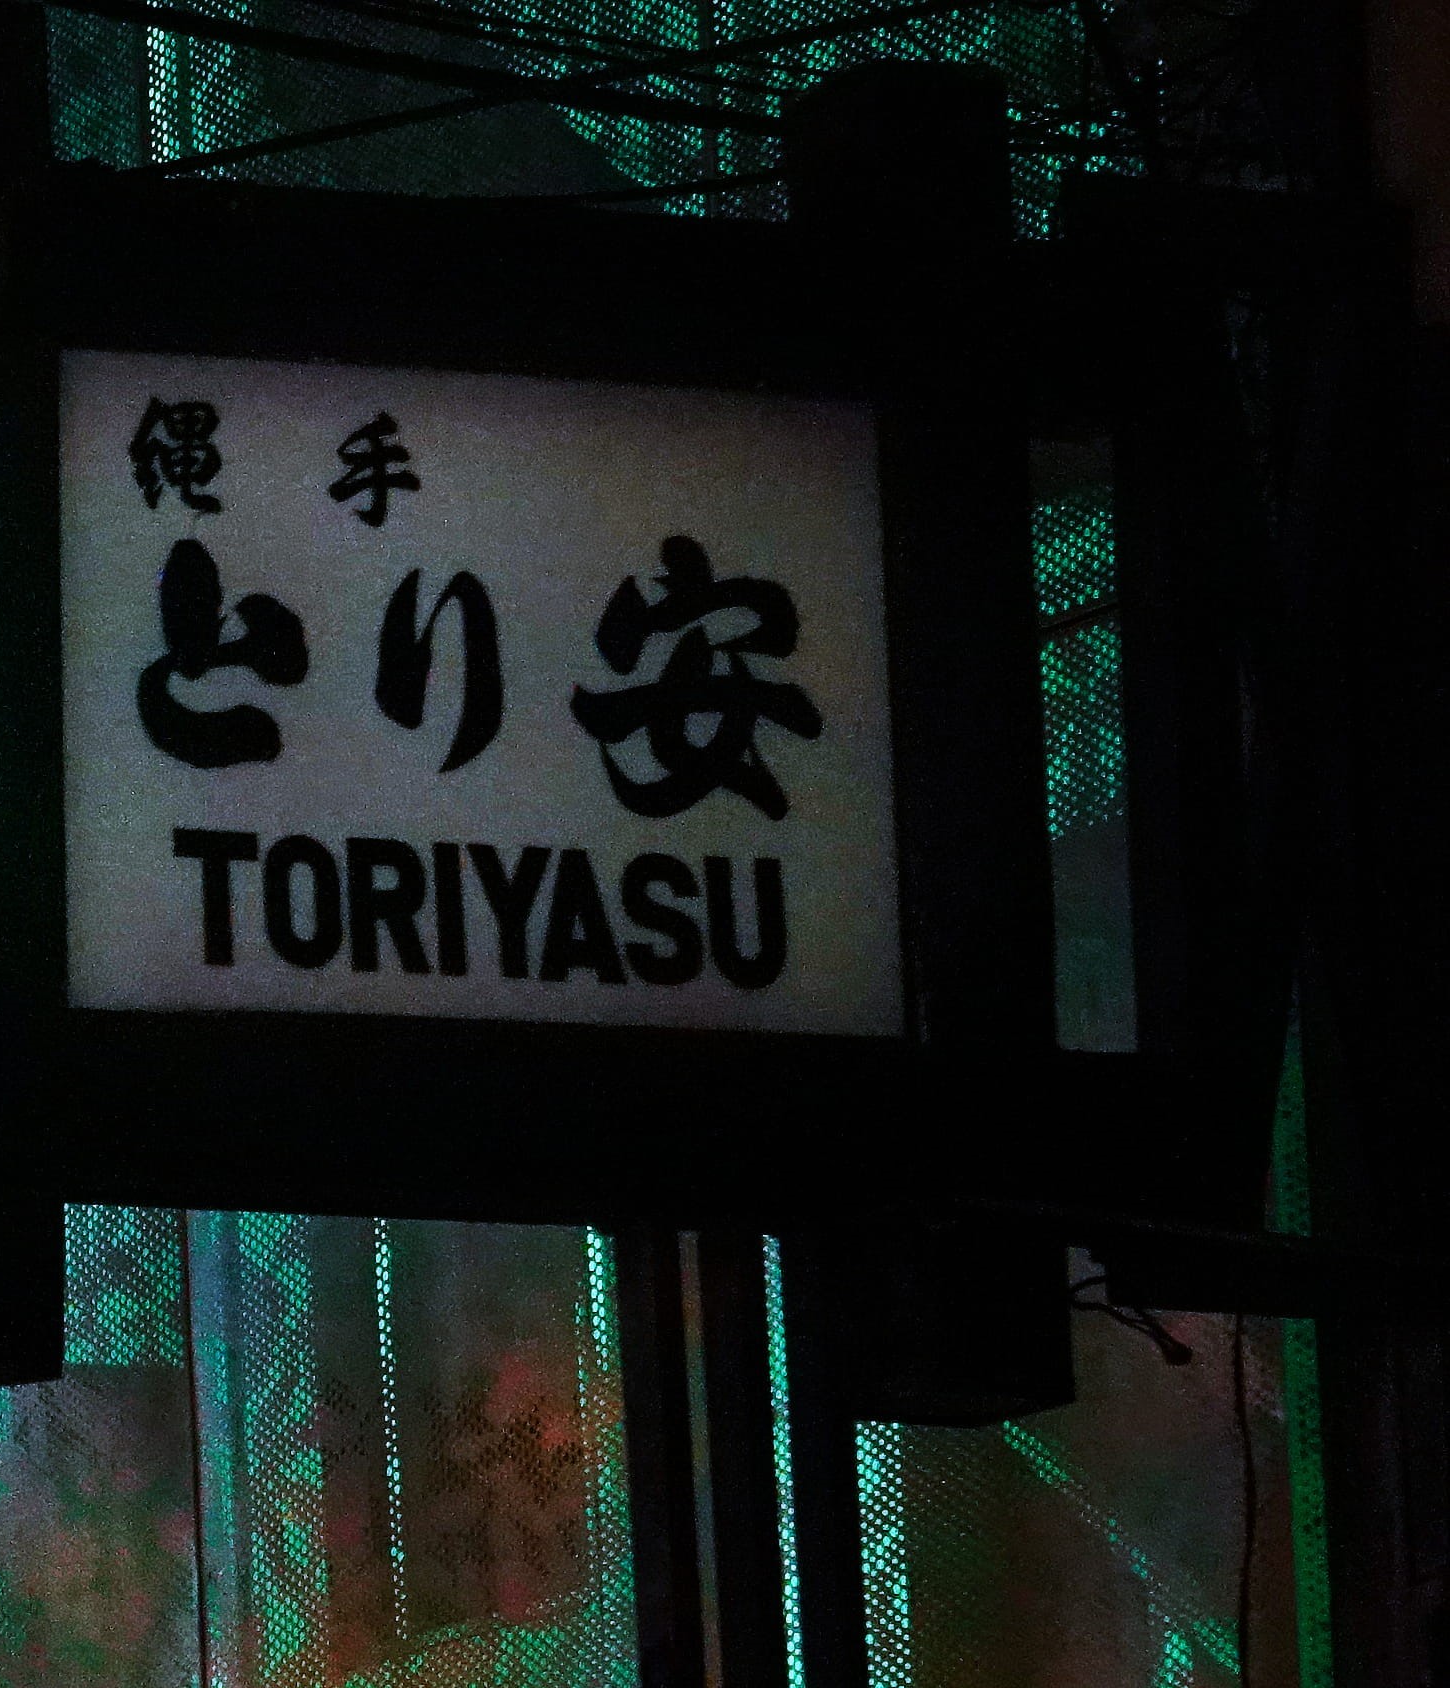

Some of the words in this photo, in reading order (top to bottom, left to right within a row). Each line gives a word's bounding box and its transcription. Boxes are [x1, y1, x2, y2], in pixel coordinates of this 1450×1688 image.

[136, 535, 824, 820] とり安
[172, 827, 788, 990] TORIYASU
